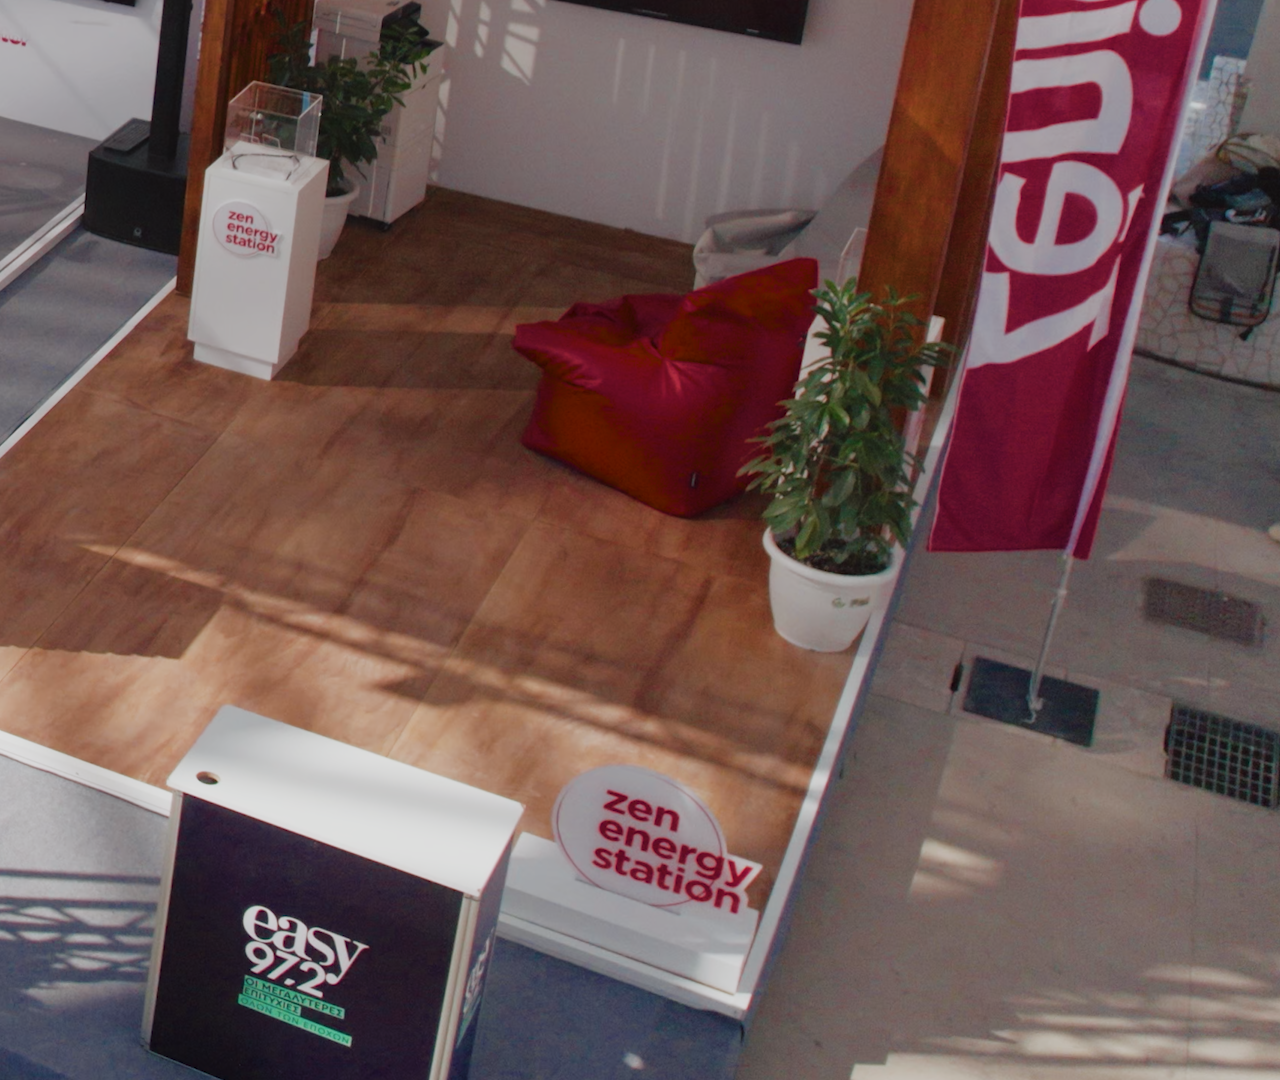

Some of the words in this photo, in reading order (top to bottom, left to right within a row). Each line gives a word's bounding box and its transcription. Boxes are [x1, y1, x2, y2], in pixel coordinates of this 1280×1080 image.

[227, 222, 278, 243] energy
[228, 210, 254, 224] zen
[226, 234, 275, 254] station
[603, 789, 680, 832] zen
[598, 819, 754, 888] energy
[592, 847, 741, 914] station
[242, 905, 370, 985] easy
[245, 940, 326, 998] 97.2
[244, 987, 301, 1015] ΕΠΙΤΥΧΙΕΣ
[262, 982, 344, 1018] ΜΕΓΑΛΥΤΕΡΕΣ
